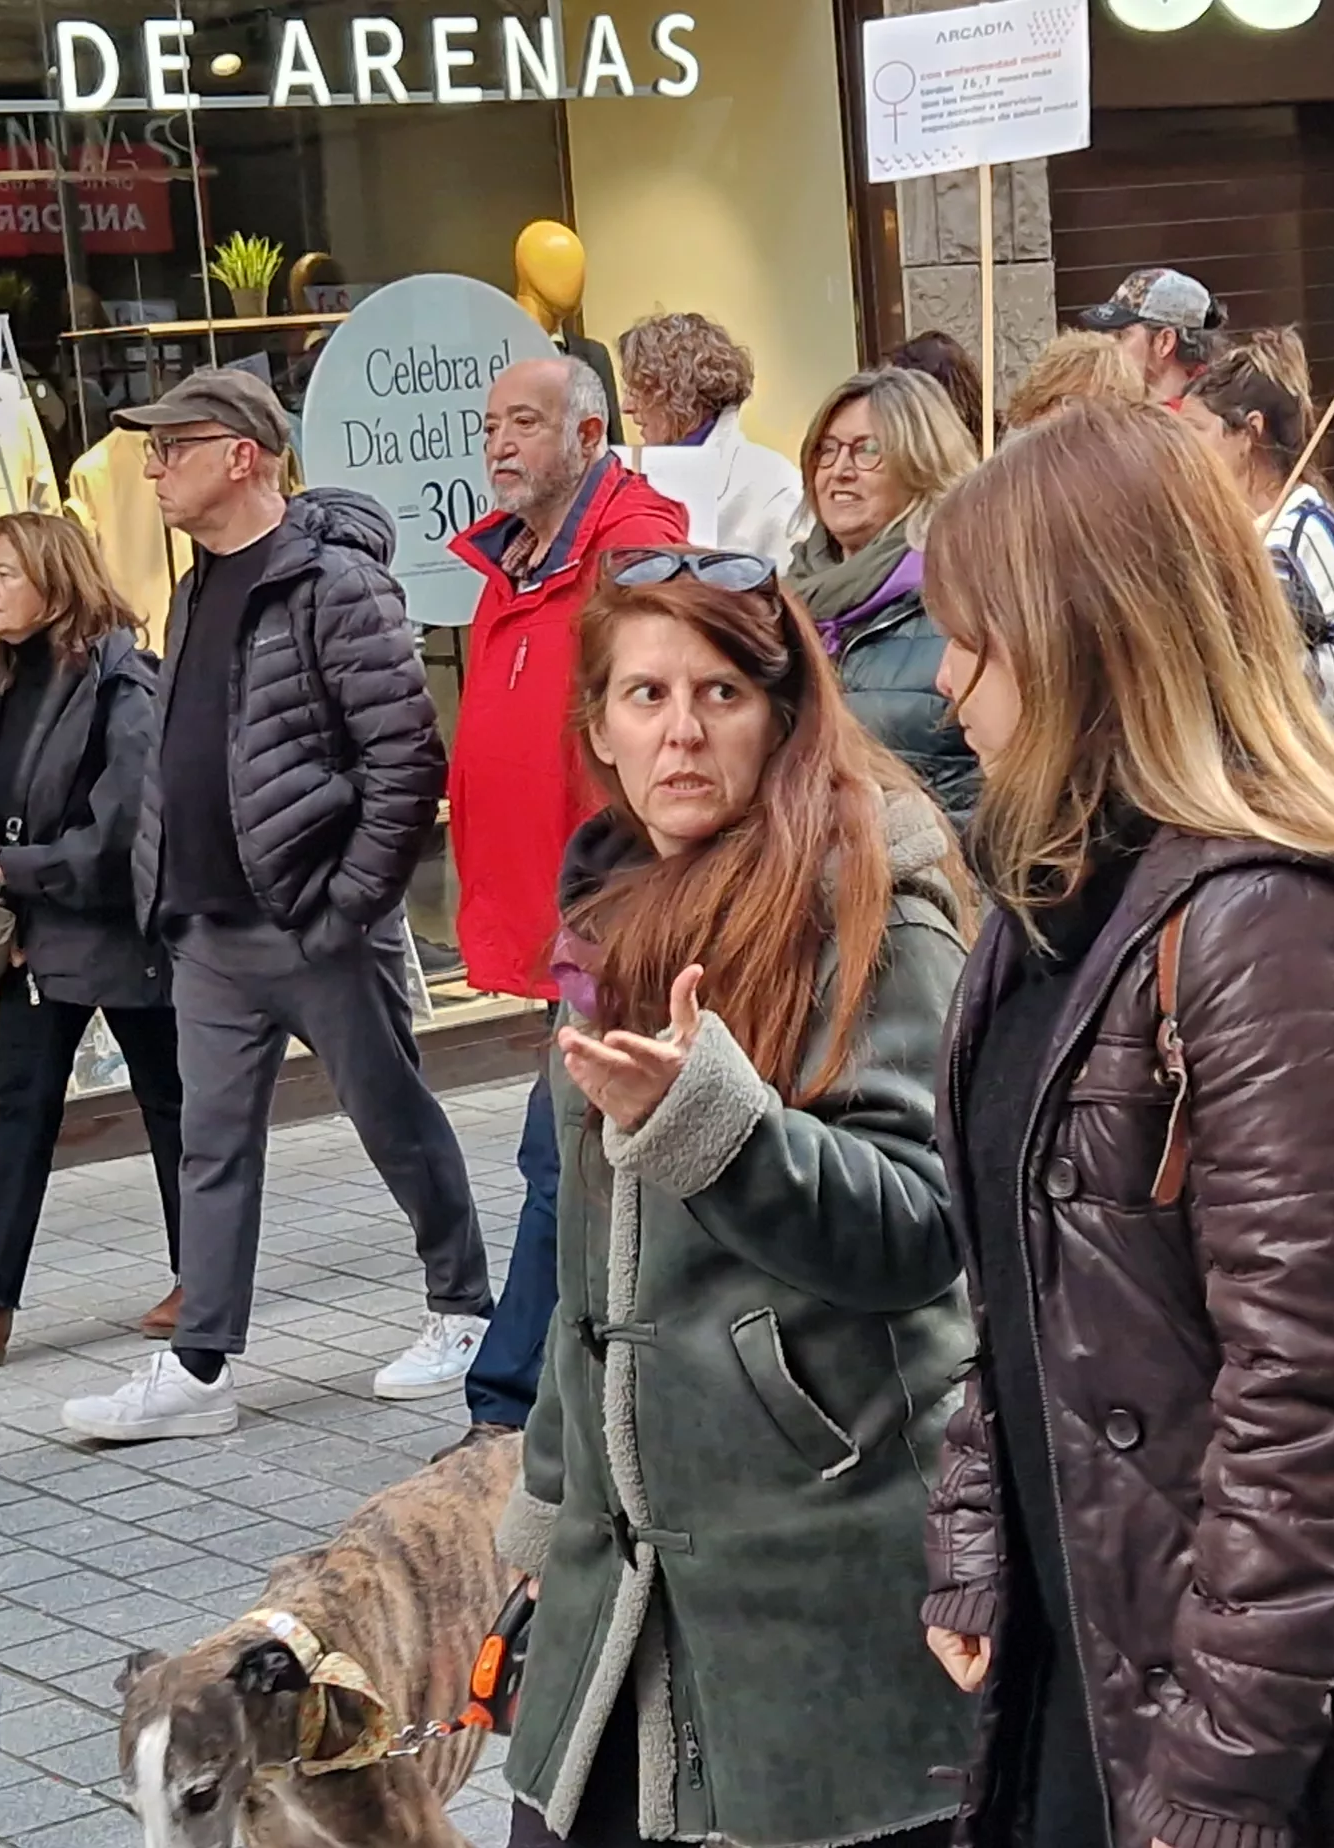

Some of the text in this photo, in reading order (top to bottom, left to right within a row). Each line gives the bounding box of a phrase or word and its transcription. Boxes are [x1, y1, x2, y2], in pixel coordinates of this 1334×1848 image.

[935, 20, 1014, 44] ARCADIA
[55, 20, 201, 111] DE
[270, 14, 699, 107] ARENAS
[945, 57, 1017, 77] enfermedad
[1021, 47, 1061, 64] mental
[366, 344, 483, 398] Celebra
[341, 417, 403, 469] Día
[410, 411, 456, 461] del
